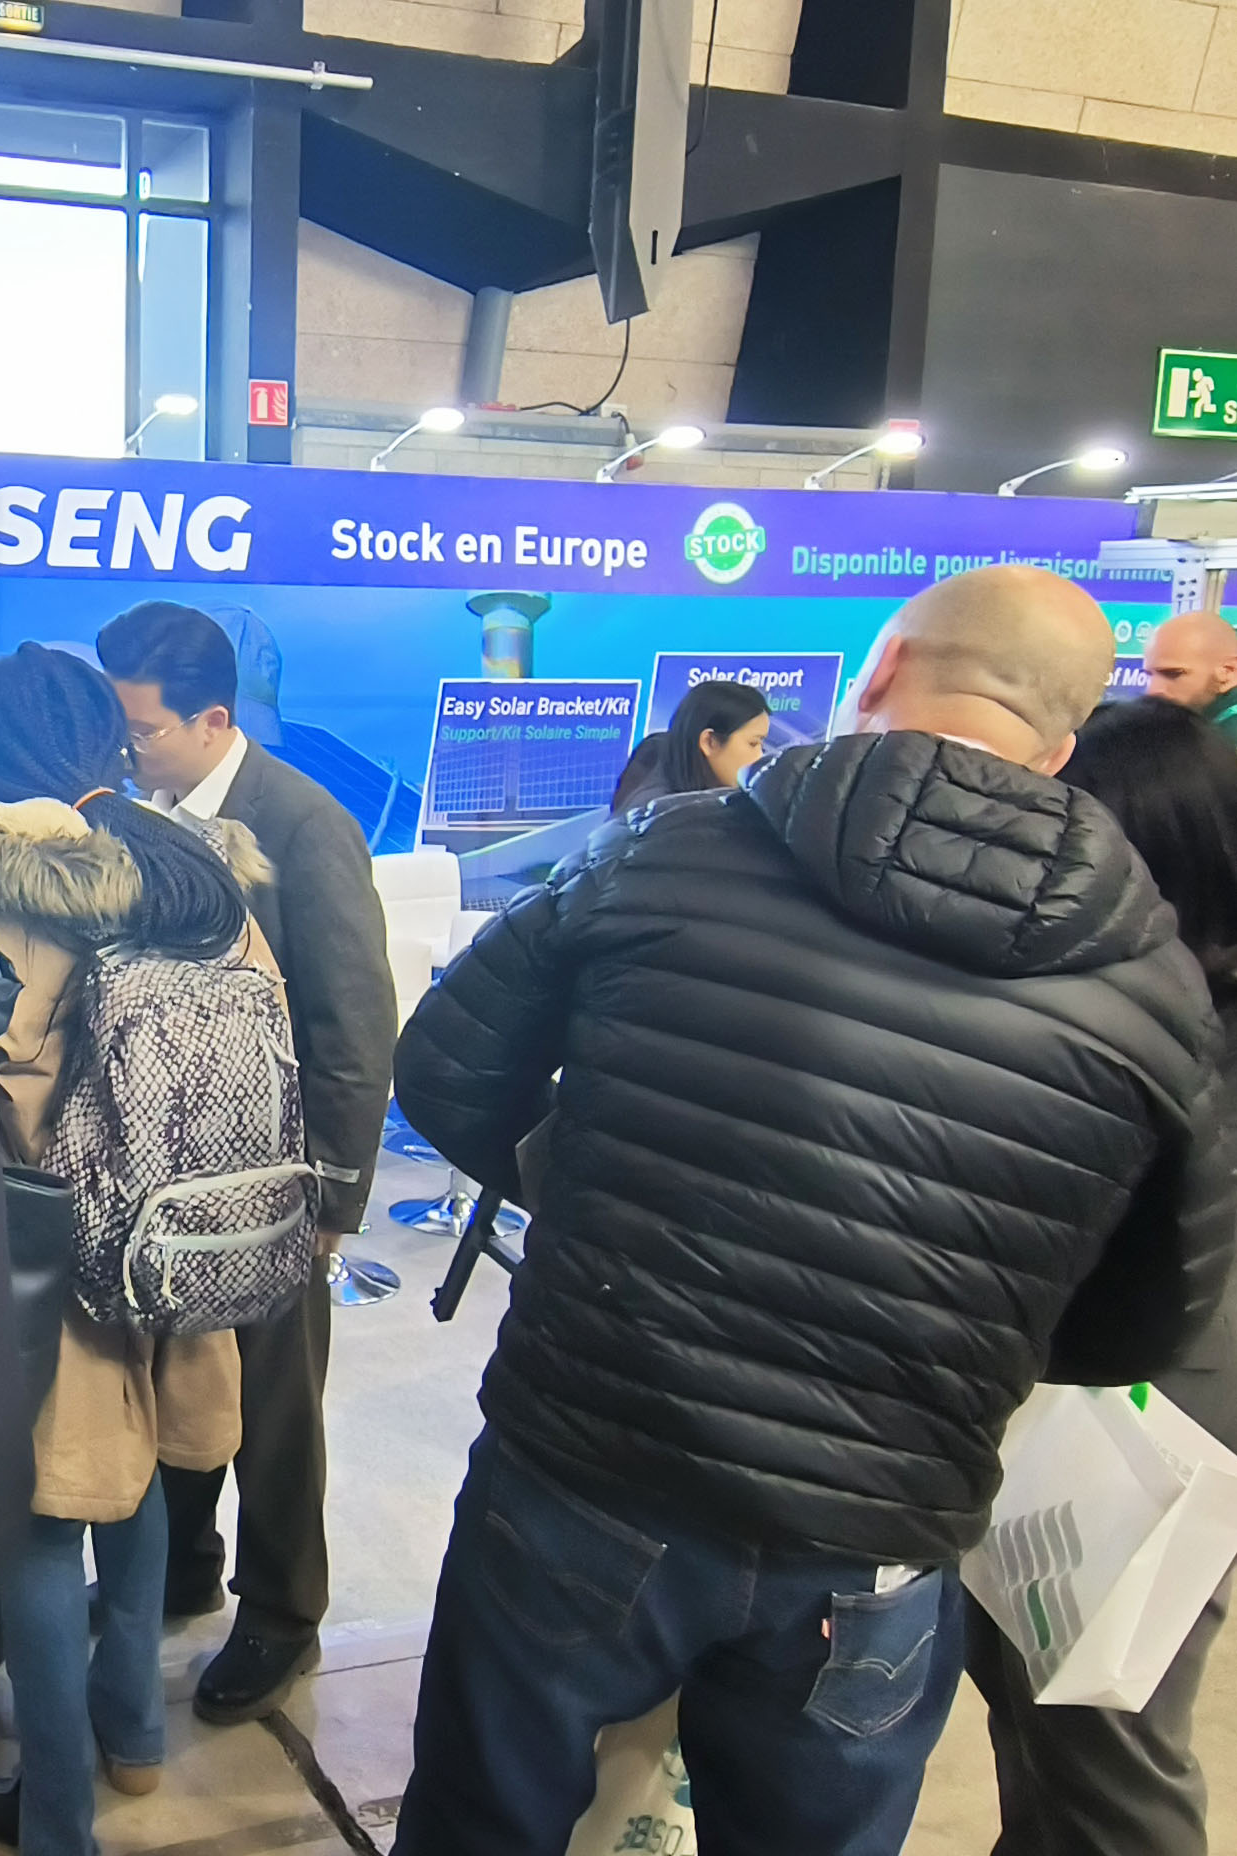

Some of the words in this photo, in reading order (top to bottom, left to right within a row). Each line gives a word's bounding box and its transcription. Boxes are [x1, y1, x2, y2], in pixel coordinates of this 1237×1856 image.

[331, 518, 445, 562] Stock
[455, 531, 502, 563] en
[515, 526, 648, 577] Europe
[690, 531, 760, 558] STOCK
[792, 546, 928, 582] Disponible
[737, 667, 804, 691] Carport
[443, 696, 485, 721] Easy
[488, 696, 535, 716] Solar
[537, 695, 631, 716] Bracket/Kit
[440, 725, 522, 744] Support/Kit
[524, 724, 573, 741] Solaire
[575, 725, 622, 743] Simple
